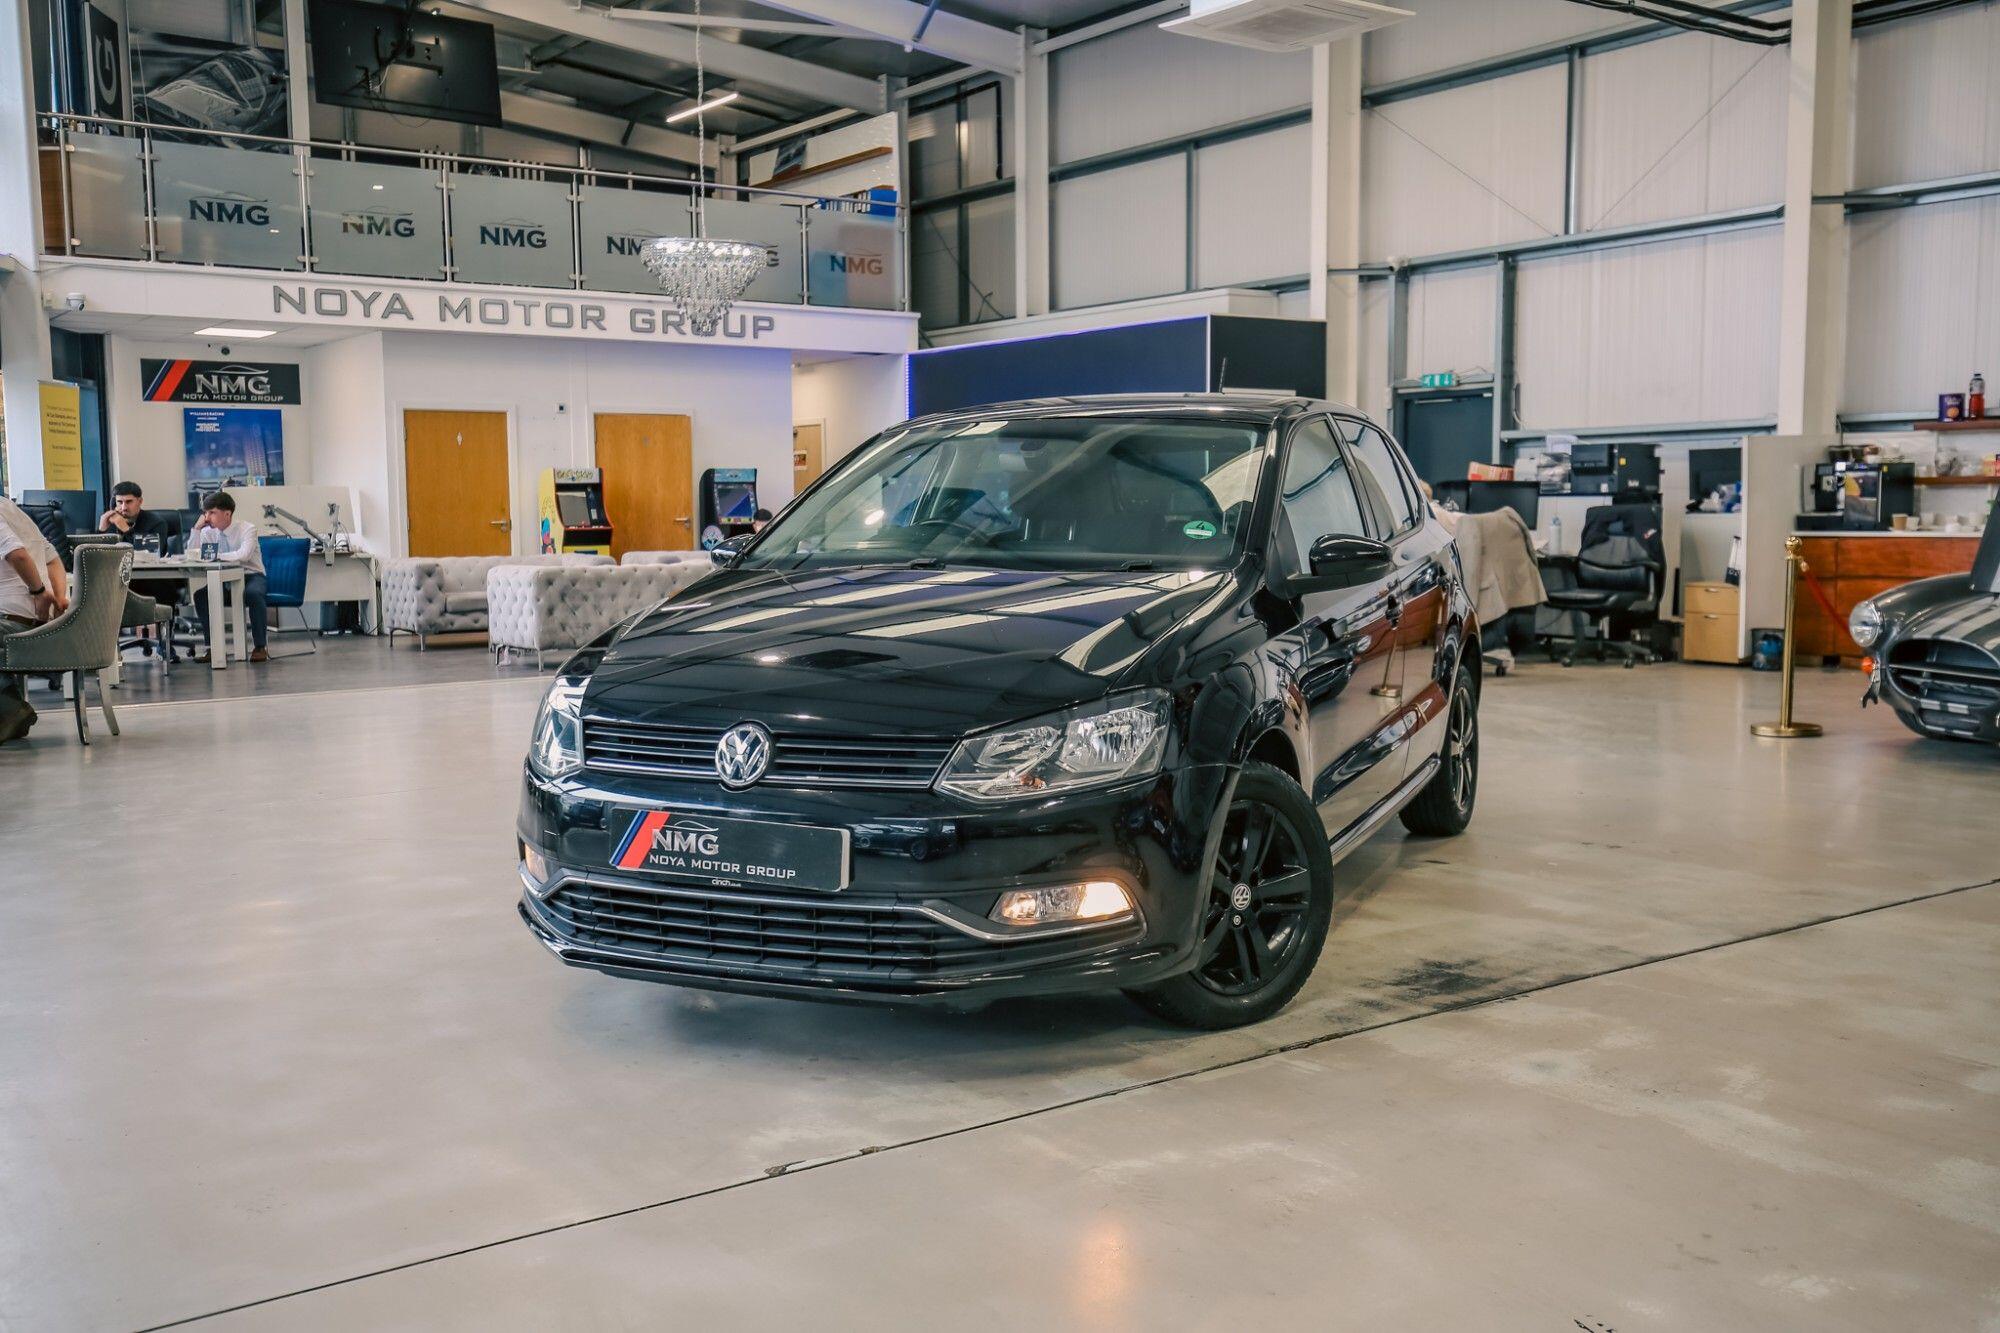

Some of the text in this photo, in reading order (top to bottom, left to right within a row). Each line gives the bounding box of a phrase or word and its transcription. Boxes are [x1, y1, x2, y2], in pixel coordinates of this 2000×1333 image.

[188, 200, 270, 226] NMG
[341, 215, 415, 238] NMG
[479, 225, 547, 249] NMG
[606, 235, 643, 256] NM
[830, 254, 883, 276] NMG
[272, 284, 414, 321] NOYA
[438, 294, 606, 332] MOTOR
[195, 373, 271, 395] NMG
[182, 392, 284, 403] NOYA MOTOR GROUP
[650, 828, 719, 855] NMG
[649, 854, 796, 880] NOYA MOTOR GROUP
